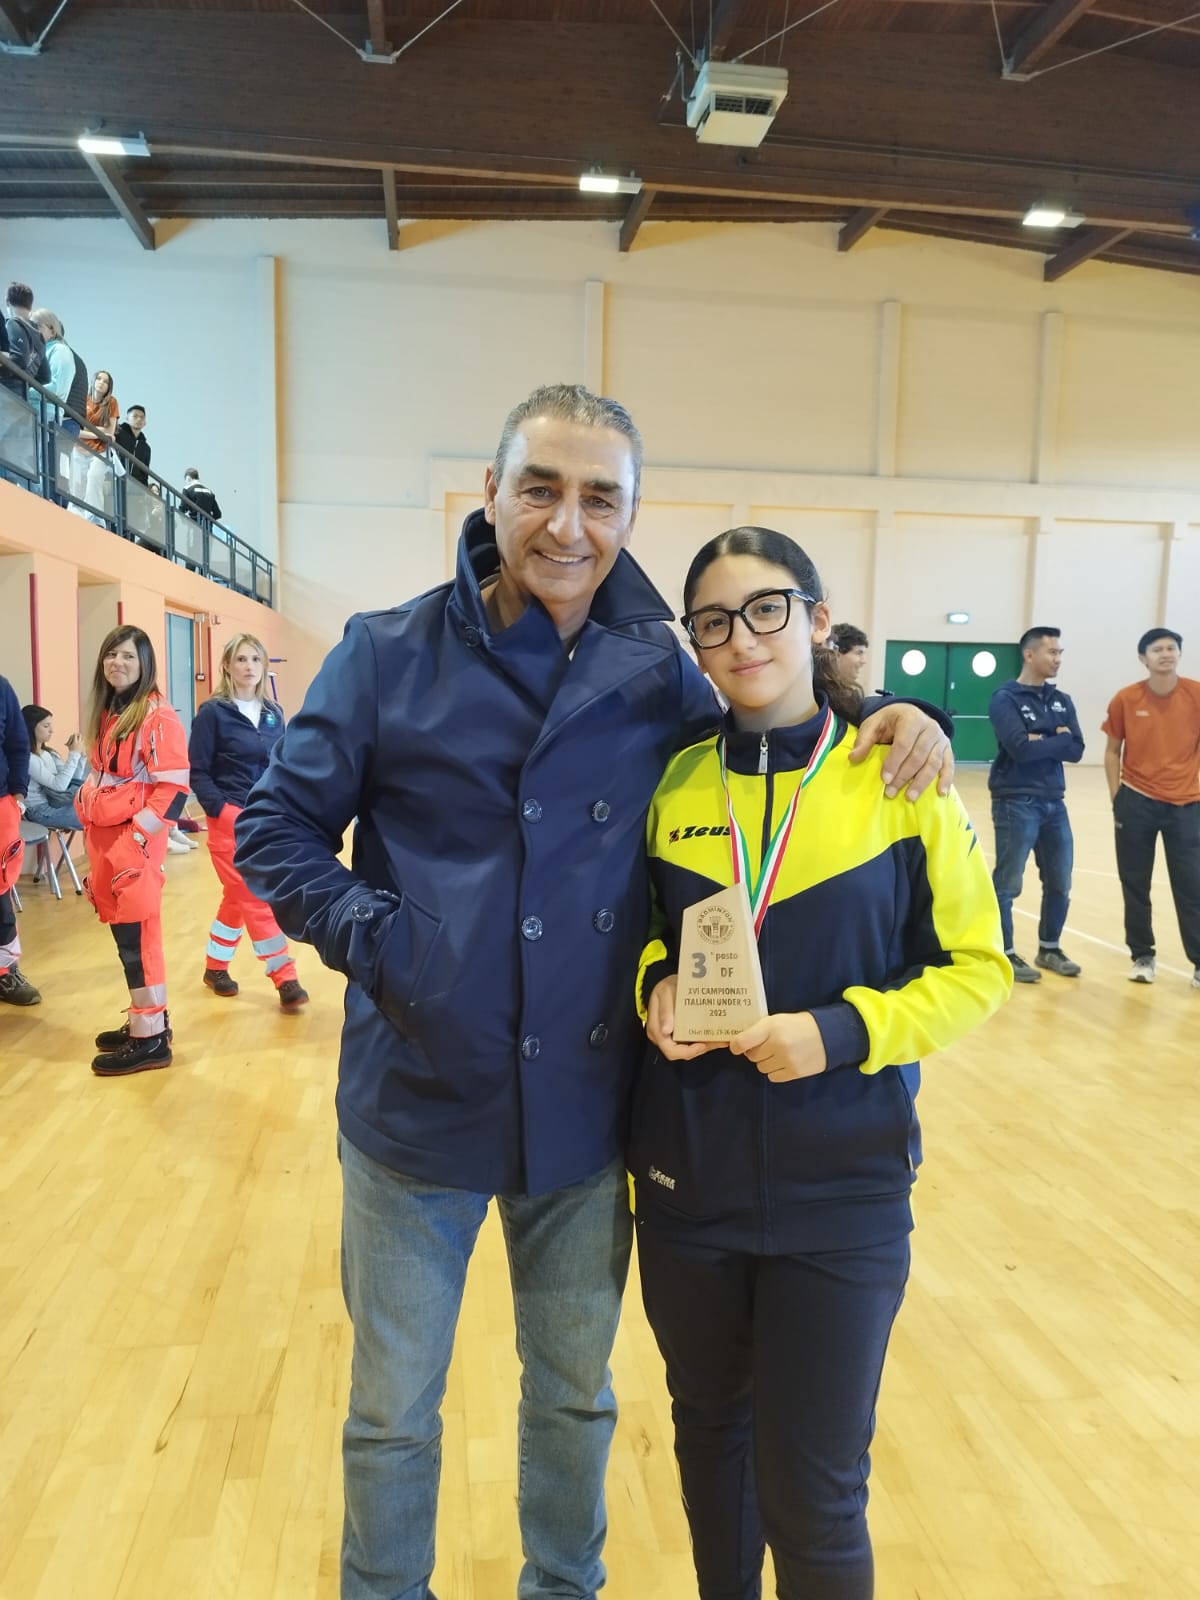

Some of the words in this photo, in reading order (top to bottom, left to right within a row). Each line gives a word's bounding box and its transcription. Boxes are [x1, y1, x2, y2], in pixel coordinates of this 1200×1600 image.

[680, 825, 731, 840] Zeus
[715, 952, 738, 962] posto
[720, 967, 734, 978] DF
[701, 987, 748, 995] CAMPIONATI
[684, 998, 715, 1006] ITALIANI
[716, 998, 741, 1006] UNDER
[743, 998, 752, 1006] 13
[709, 1009, 727, 1017] 2025
